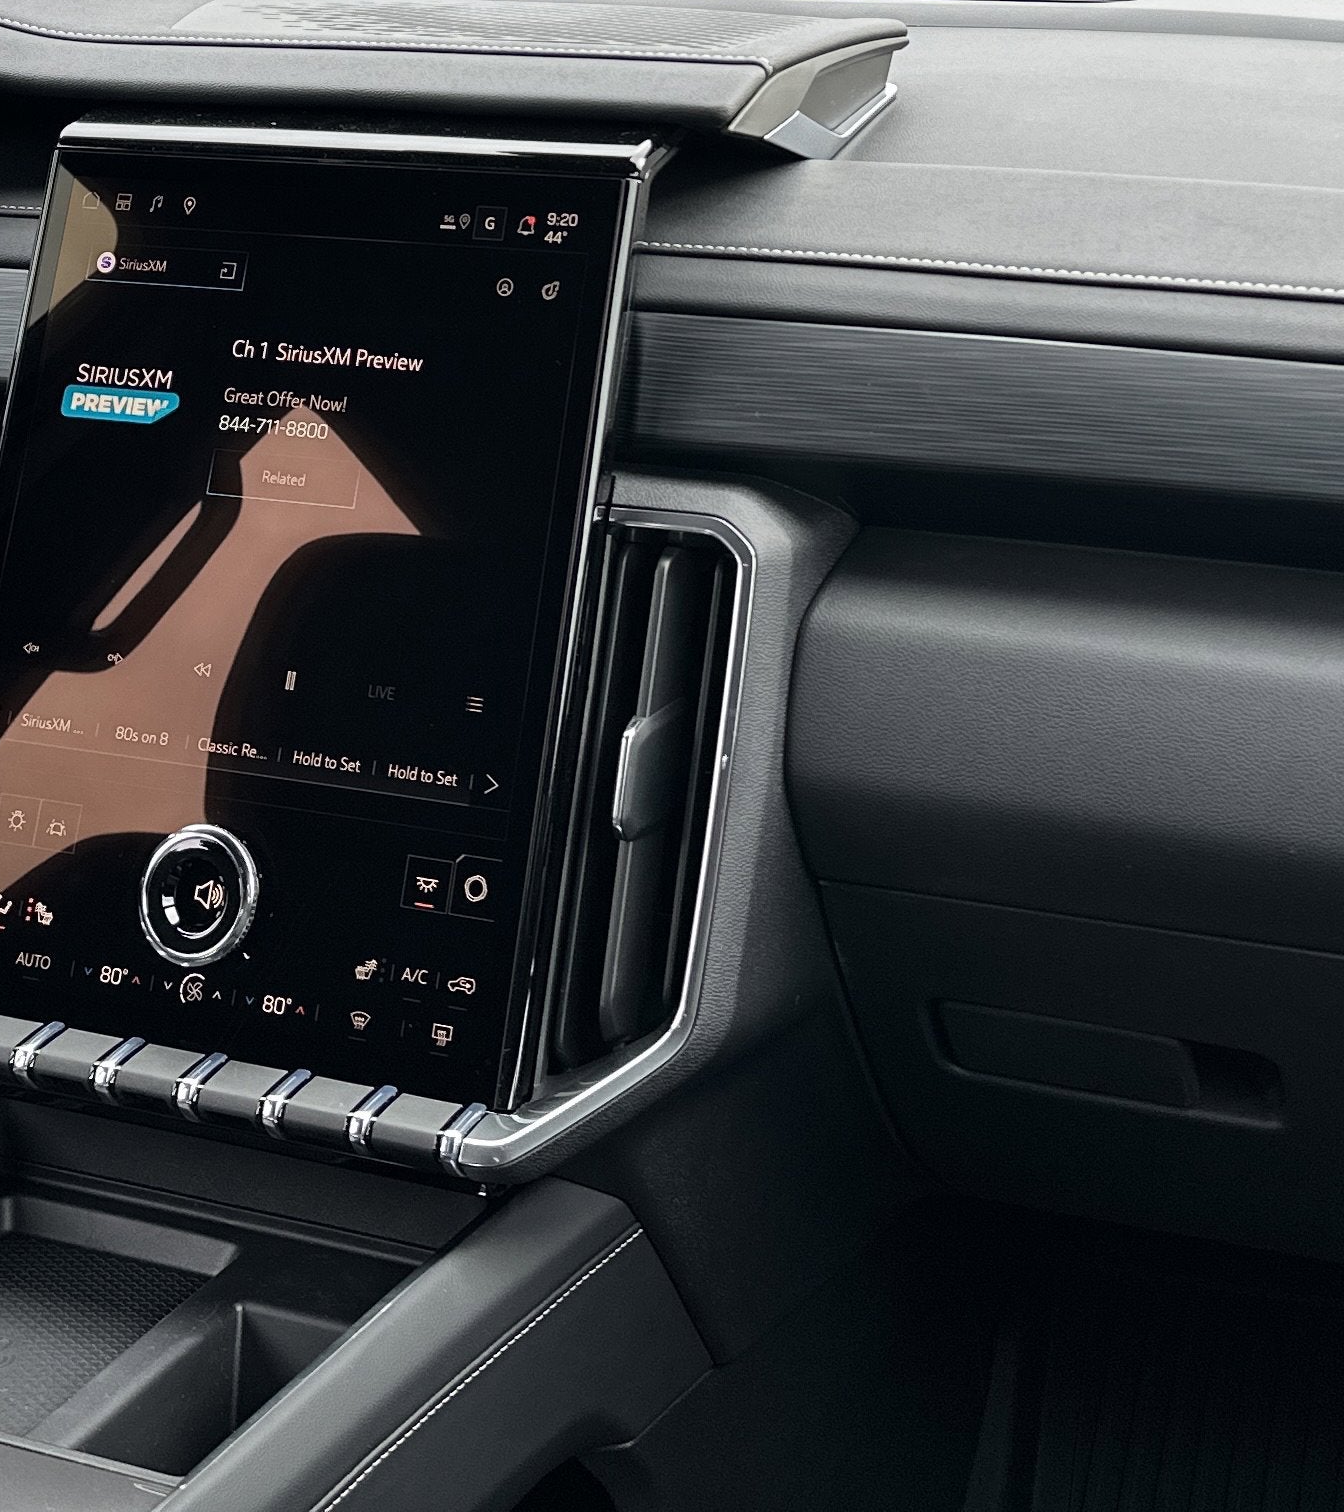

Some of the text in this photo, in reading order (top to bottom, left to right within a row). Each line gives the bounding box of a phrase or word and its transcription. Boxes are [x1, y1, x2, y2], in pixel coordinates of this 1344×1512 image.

[484, 216, 496, 230] G
[546, 212, 579, 227] 9:20
[544, 230, 568, 245] 44°
[118, 257, 167, 273] SiriusXM
[232, 339, 424, 372] Ch 1 SiriusXM Preview
[76, 363, 173, 389] SIRIUSXM
[70, 392, 169, 417] PREVIEW
[224, 387, 348, 413] Great Offer Now!
[218, 415, 329, 440] 844-711-8800
[262, 470, 307, 487] Related
[367, 684, 396, 701] LIVE
[20, 712, 72, 733] SiriusXM
[115, 725, 169, 746] 80s on 8
[197, 737, 238, 756] Classic
[293, 750, 361, 774] Hold to Set
[387, 763, 458, 787] Hold to Set
[15, 951, 51, 970] AUTO
[99, 965, 128, 985] 80°
[401, 967, 429, 985] A/C
[262, 994, 292, 1015] 80°
